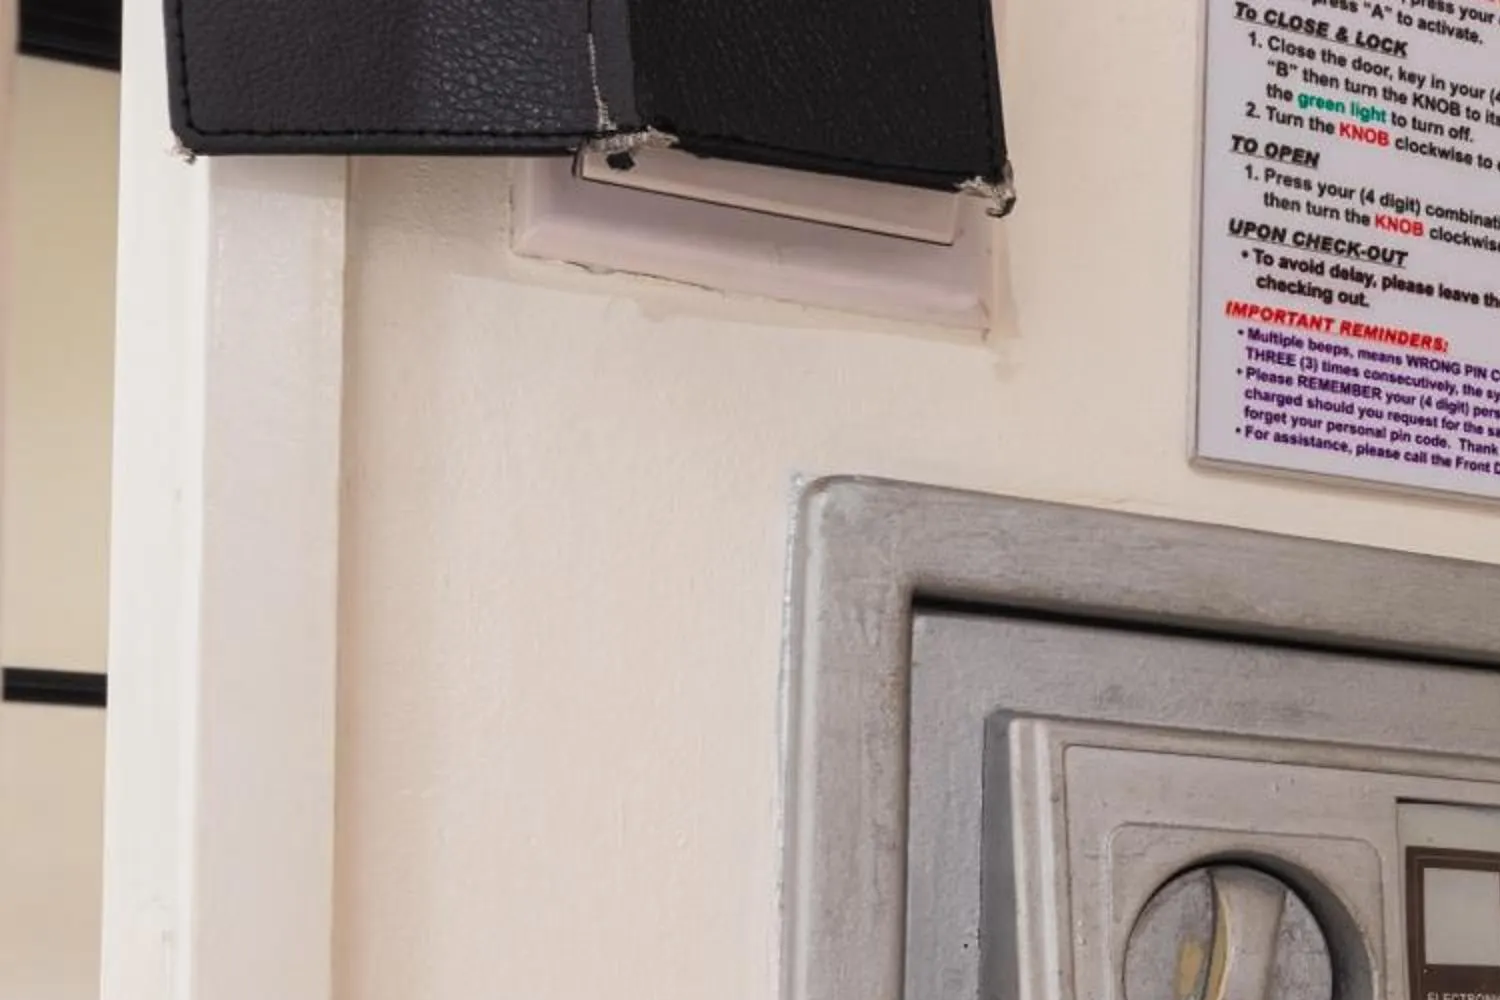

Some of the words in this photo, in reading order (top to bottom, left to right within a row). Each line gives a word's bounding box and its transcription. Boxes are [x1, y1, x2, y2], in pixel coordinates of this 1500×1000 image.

[1234, 1, 1258, 23] To
[1263, 8, 1330, 39] CLOSE
[1334, 25, 1349, 43] &
[1355, 30, 1408, 58] LOCK
[1364, 1, 1392, 19] "A"
[1397, 10, 1413, 26] to
[1417, 17, 1483, 45] activate.
[1458, 5, 1496, 24] your
[1248, 30, 1264, 49] 1.
[1267, 35, 1316, 60] Close
[1321, 49, 1347, 67] the
[1351, 56, 1394, 81] door,
[1398, 65, 1427, 89] key
[1430, 74, 1446, 90] in
[1449, 81, 1486, 99] your
[1267, 59, 1298, 77] "B"
[1302, 67, 1340, 88] then
[1344, 77, 1378, 97] turn
[1382, 86, 1408, 104] the
[1412, 91, 1461, 116] KNOB
[1465, 105, 1481, 121] to
[1245, 101, 1262, 119] 2.
[1265, 105, 1304, 128] Turn
[1308, 116, 1336, 134] the
[1339, 122, 1390, 146] KNOB
[1394, 135, 1474, 165] clockwise
[1476, 153, 1494, 169] to
[1266, 82, 1294, 102] the
[1297, 93, 1345, 113] green
[1350, 102, 1387, 122] light
[1391, 111, 1408, 127] to
[1411, 116, 1445, 135] turn
[1447, 125, 1474, 143] off.
[1231, 134, 1259, 156] TO
[1263, 141, 1321, 168] OPEN
[1244, 163, 1260, 181] 1.
[1264, 167, 1313, 191] Press
[1317, 181, 1357, 200] your
[1359, 187, 1375, 205] (4
[1379, 191, 1421, 217] digit)
[1263, 191, 1301, 211] then
[1305, 200, 1341, 219] turn
[1344, 207, 1371, 225] the
[1375, 213, 1424, 236] KNOB
[1229, 217, 1286, 245] UPON
[1292, 231, 1409, 268] CHECK-OUT
[1253, 247, 1274, 266] To
[1279, 256, 1325, 275] avoid
[1330, 264, 1378, 289] delay,
[1381, 274, 1434, 296] please
[1438, 282, 1480, 304] leave
[1255, 273, 1333, 304] checking
[1337, 291, 1371, 308] out.
[1226, 300, 1333, 330] IMPORTANT
[1340, 319, 1449, 353] REMINDERS:
[1245, 365, 1293, 385] Please
[1297, 375, 1382, 399] REMEMBER
[1385, 392, 1416, 404] your
[1419, 395, 1432, 409] (4
[1435, 399, 1469, 415] digit)
[1243, 404, 1287, 424] forget
[1290, 416, 1323, 428] your
[1326, 421, 1387, 438] personal
[1389, 429, 1412, 442] pin
[1459, 437, 1499, 455] Thank
[1244, 423, 1271, 440] For
[1355, 442, 1401, 459] please
[1403, 450, 1428, 463] call
[1430, 453, 1452, 467] the
[1455, 455, 1491, 472] Front
